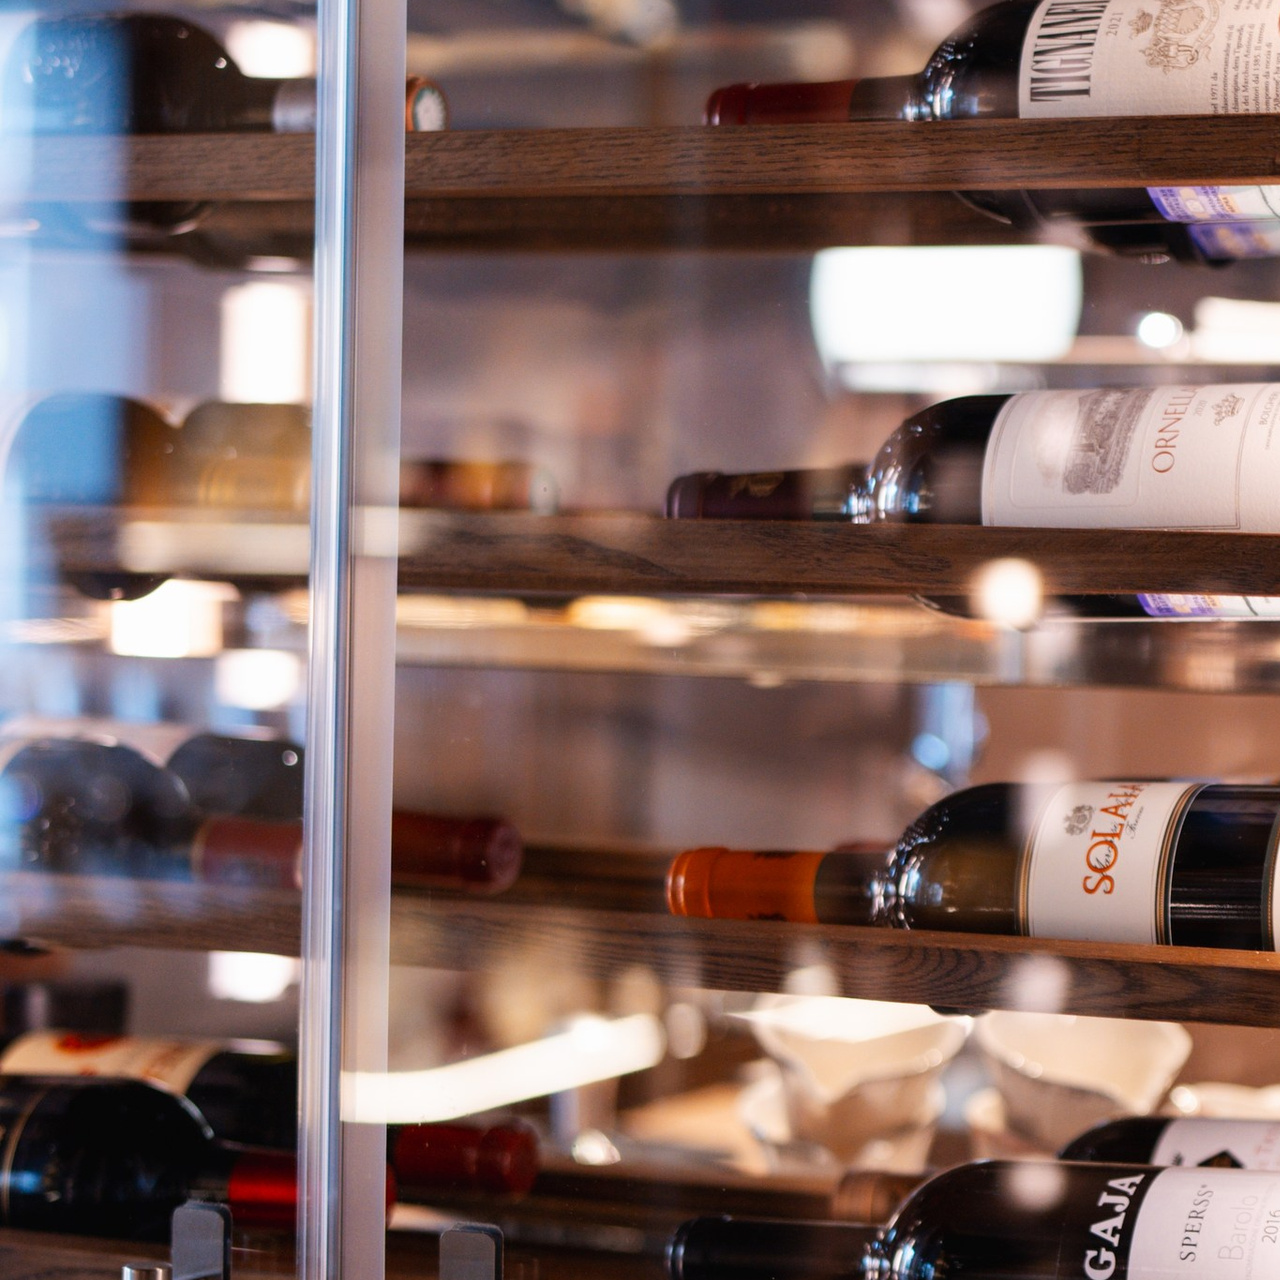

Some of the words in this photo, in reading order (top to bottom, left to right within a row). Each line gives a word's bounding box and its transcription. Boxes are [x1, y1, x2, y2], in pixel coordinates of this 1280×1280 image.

[1105, 11, 1124, 37] 2021
[1211, 72, 1218, 81] da
[1242, 60, 1250, 92] Marchesi
[1217, 1195, 1258, 1261] Barolo
